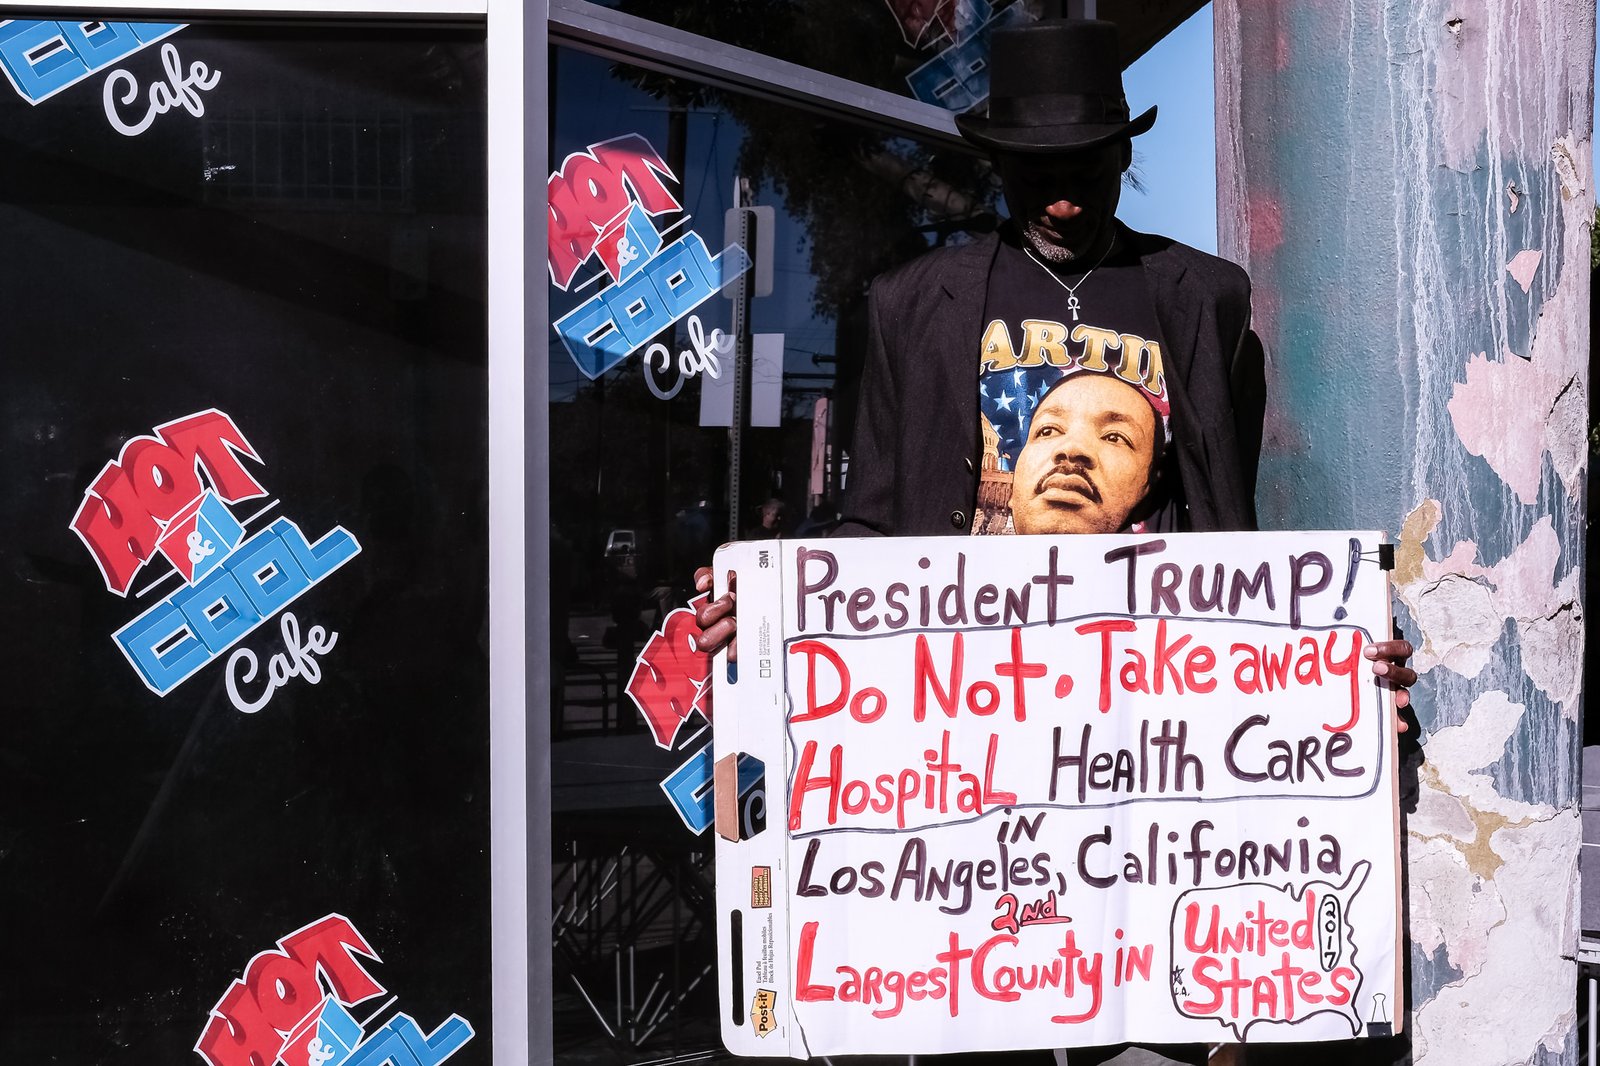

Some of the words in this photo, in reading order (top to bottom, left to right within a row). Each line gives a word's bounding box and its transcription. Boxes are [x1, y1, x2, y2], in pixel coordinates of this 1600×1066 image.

[103, 43, 222, 136] Cafe
[616, 237, 639, 266] &
[553, 230, 753, 380] COOL
[643, 315, 736, 400] Cafe
[69, 408, 269, 598] HOT
[187, 530, 215, 564] &
[759, 550, 768, 568] 3M
[1105, 538, 1363, 630] TRUMP!
[111, 516, 362, 698] COOL
[225, 612, 338, 714] Cafe
[789, 640, 887, 723] Do
[1075, 618, 1218, 713] Take
[796, 838, 885, 898] Los
[1324, 901, 1336, 969] 2017
[193, 912, 388, 1066] HOT
[759, 993, 768, 1031] Post-it
